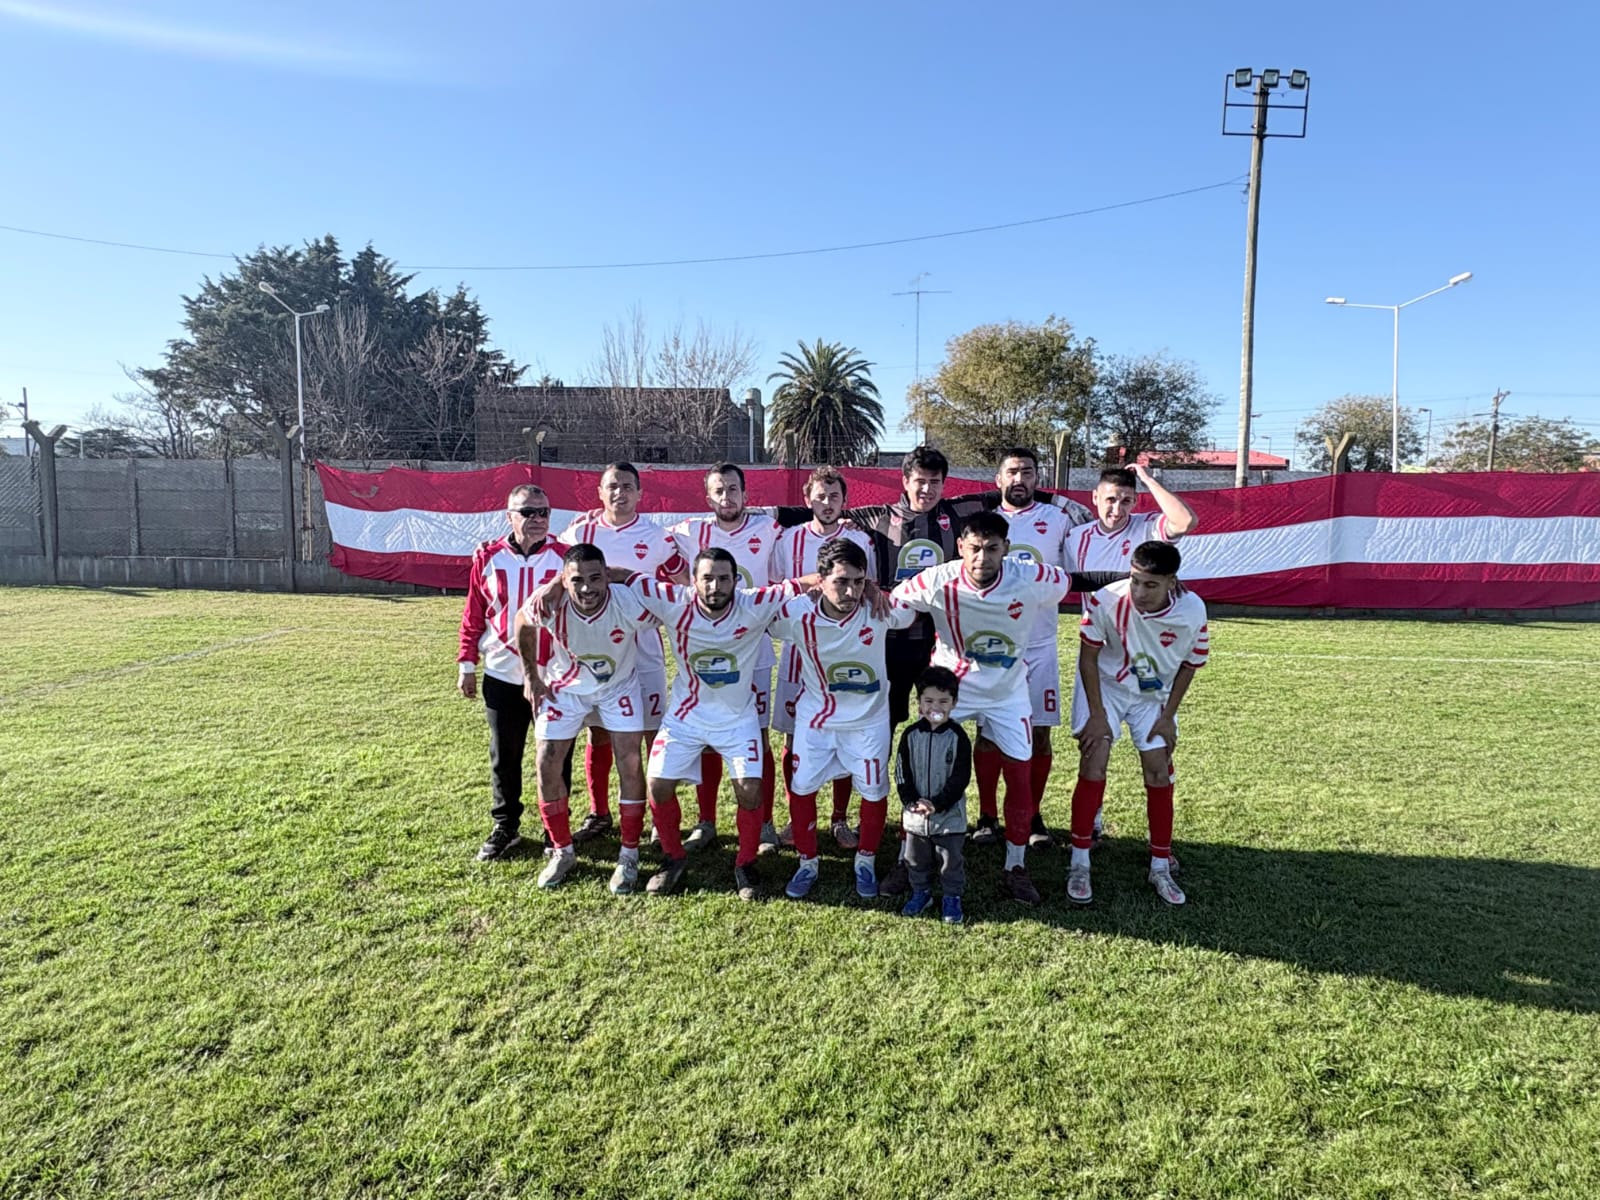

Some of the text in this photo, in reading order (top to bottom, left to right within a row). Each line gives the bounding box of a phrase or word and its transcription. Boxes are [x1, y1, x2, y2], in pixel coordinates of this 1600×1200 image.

[907, 549, 932, 565] SP
[697, 657, 726, 669] SP
[835, 669, 862, 682] SP
[618, 695, 634, 717] 9
[649, 693, 662, 716] 2
[755, 691, 767, 715] 5
[1044, 689, 1056, 712] 6
[1020, 716, 1032, 744] 1
[747, 739, 759, 762] 3
[863, 758, 880, 785] 11
